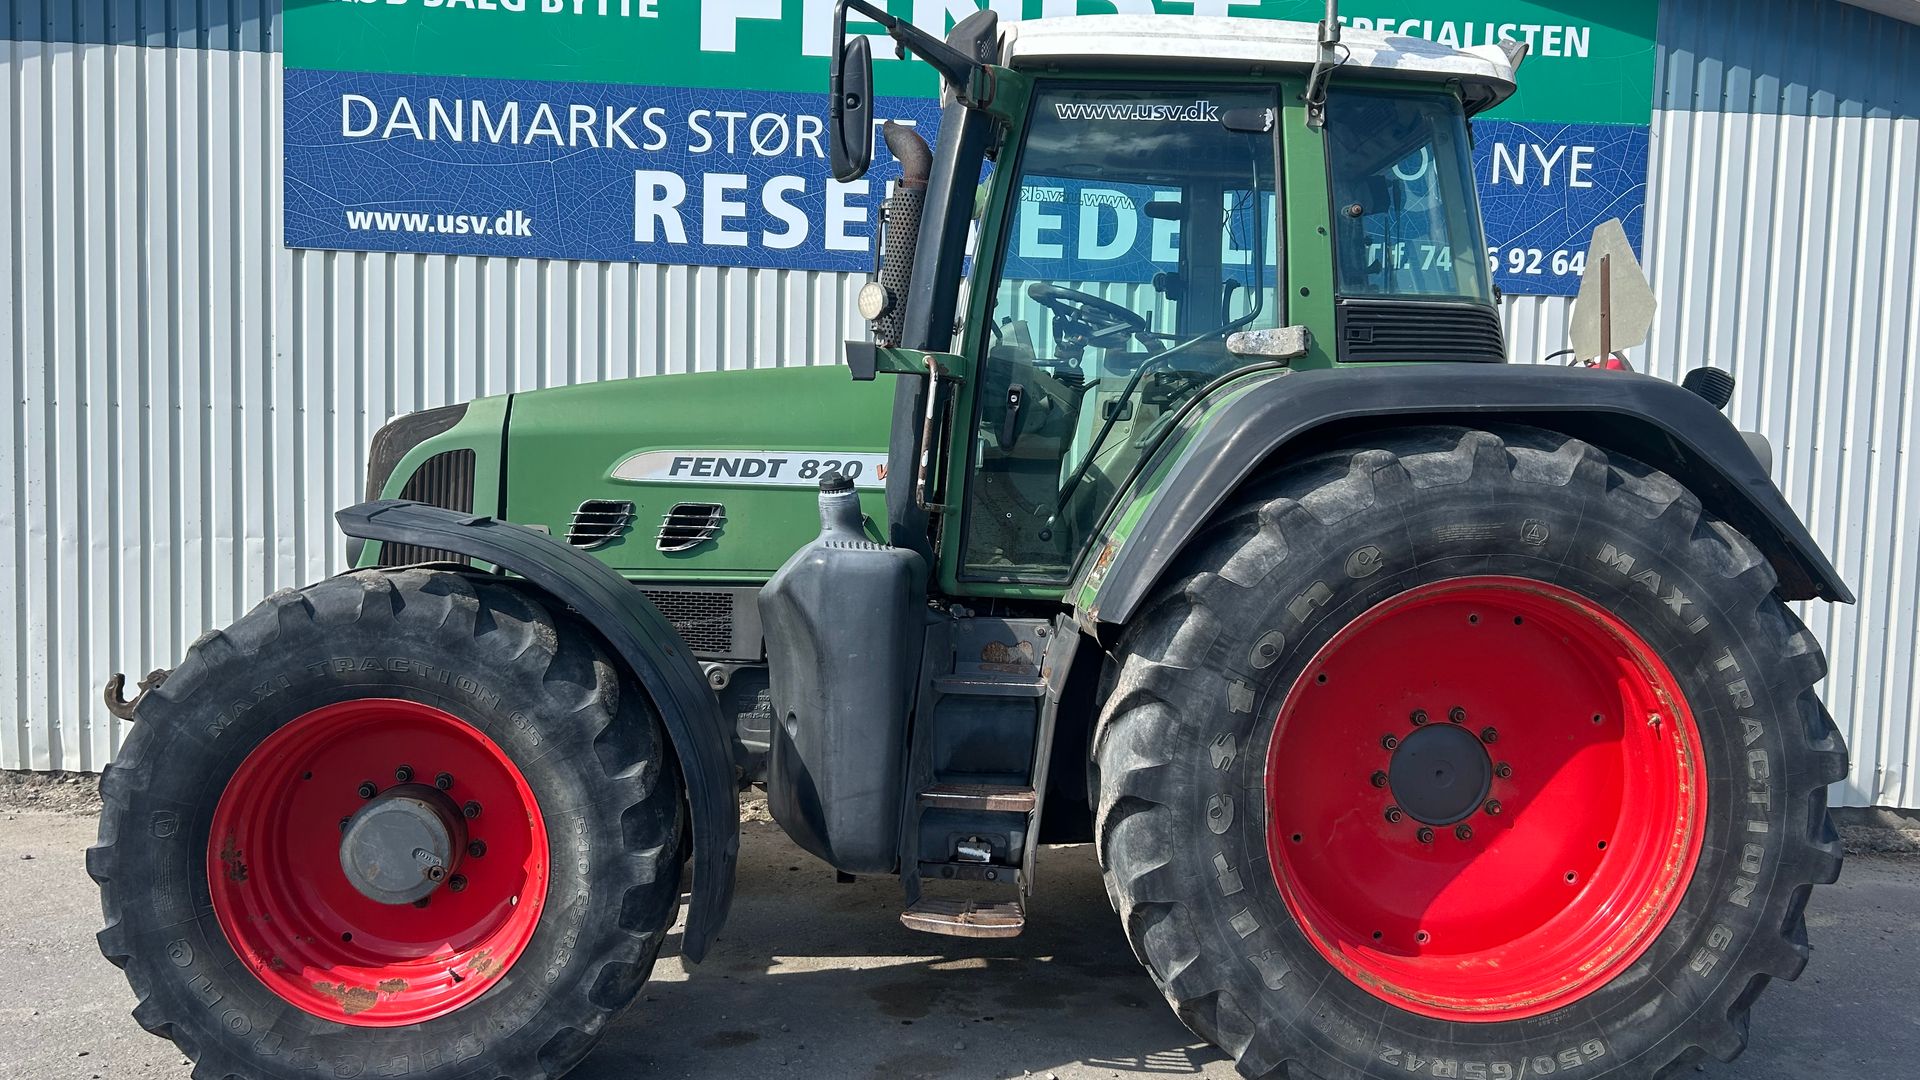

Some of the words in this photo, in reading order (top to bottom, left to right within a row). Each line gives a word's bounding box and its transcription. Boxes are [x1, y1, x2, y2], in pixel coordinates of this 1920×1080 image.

[1335, 15, 1590, 58] CIALISTEN
[1055, 101, 1219, 122] www.usv.dk
[341, 94, 667, 152] DANMARKS
[1491, 142, 1595, 188] NYE
[346, 209, 532, 237] www.usv.dk
[1420, 245, 1452, 272] 74
[1508, 247, 1543, 275] 92
[1552, 249, 1586, 277] 64
[668, 457, 788, 479] FENDT
[798, 459, 863, 481] 820
[1597, 541, 1710, 637] MAXI
[204, 671, 294, 741] MAXI
[306, 655, 503, 710] TRACTION
[507, 708, 546, 749] 65
[1714, 646, 1774, 909] TRACTION
[543, 815, 592, 985] 540/65R30
[1689, 933, 1734, 979] 65
[1377, 1037, 1607, 1080] 650/65R42
